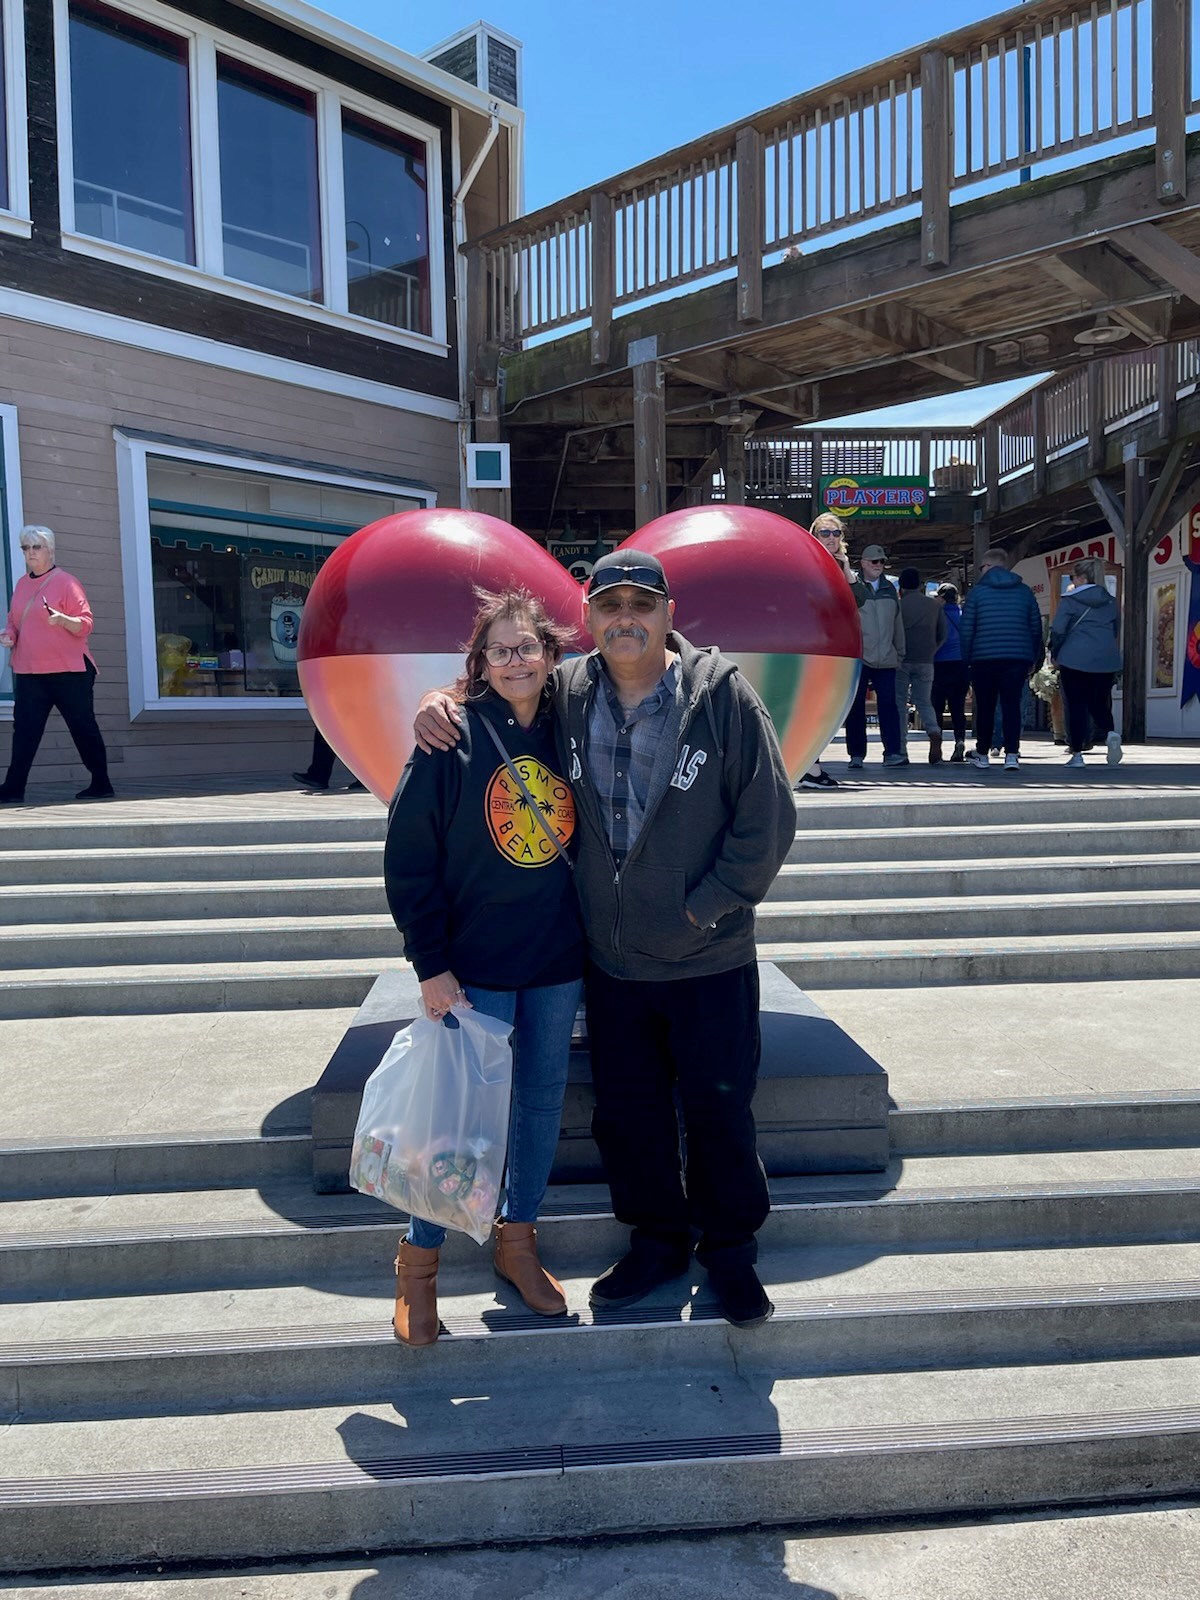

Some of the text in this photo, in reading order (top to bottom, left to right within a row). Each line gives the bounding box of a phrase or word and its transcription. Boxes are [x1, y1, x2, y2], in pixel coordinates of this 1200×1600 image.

[826, 489, 925, 505] PLAYERS
[552, 546, 580, 558] CANDY
[251, 566, 285, 589] CANDY
[499, 765, 568, 800] PISMO
[492, 800, 576, 818] CENTRAL COAST
